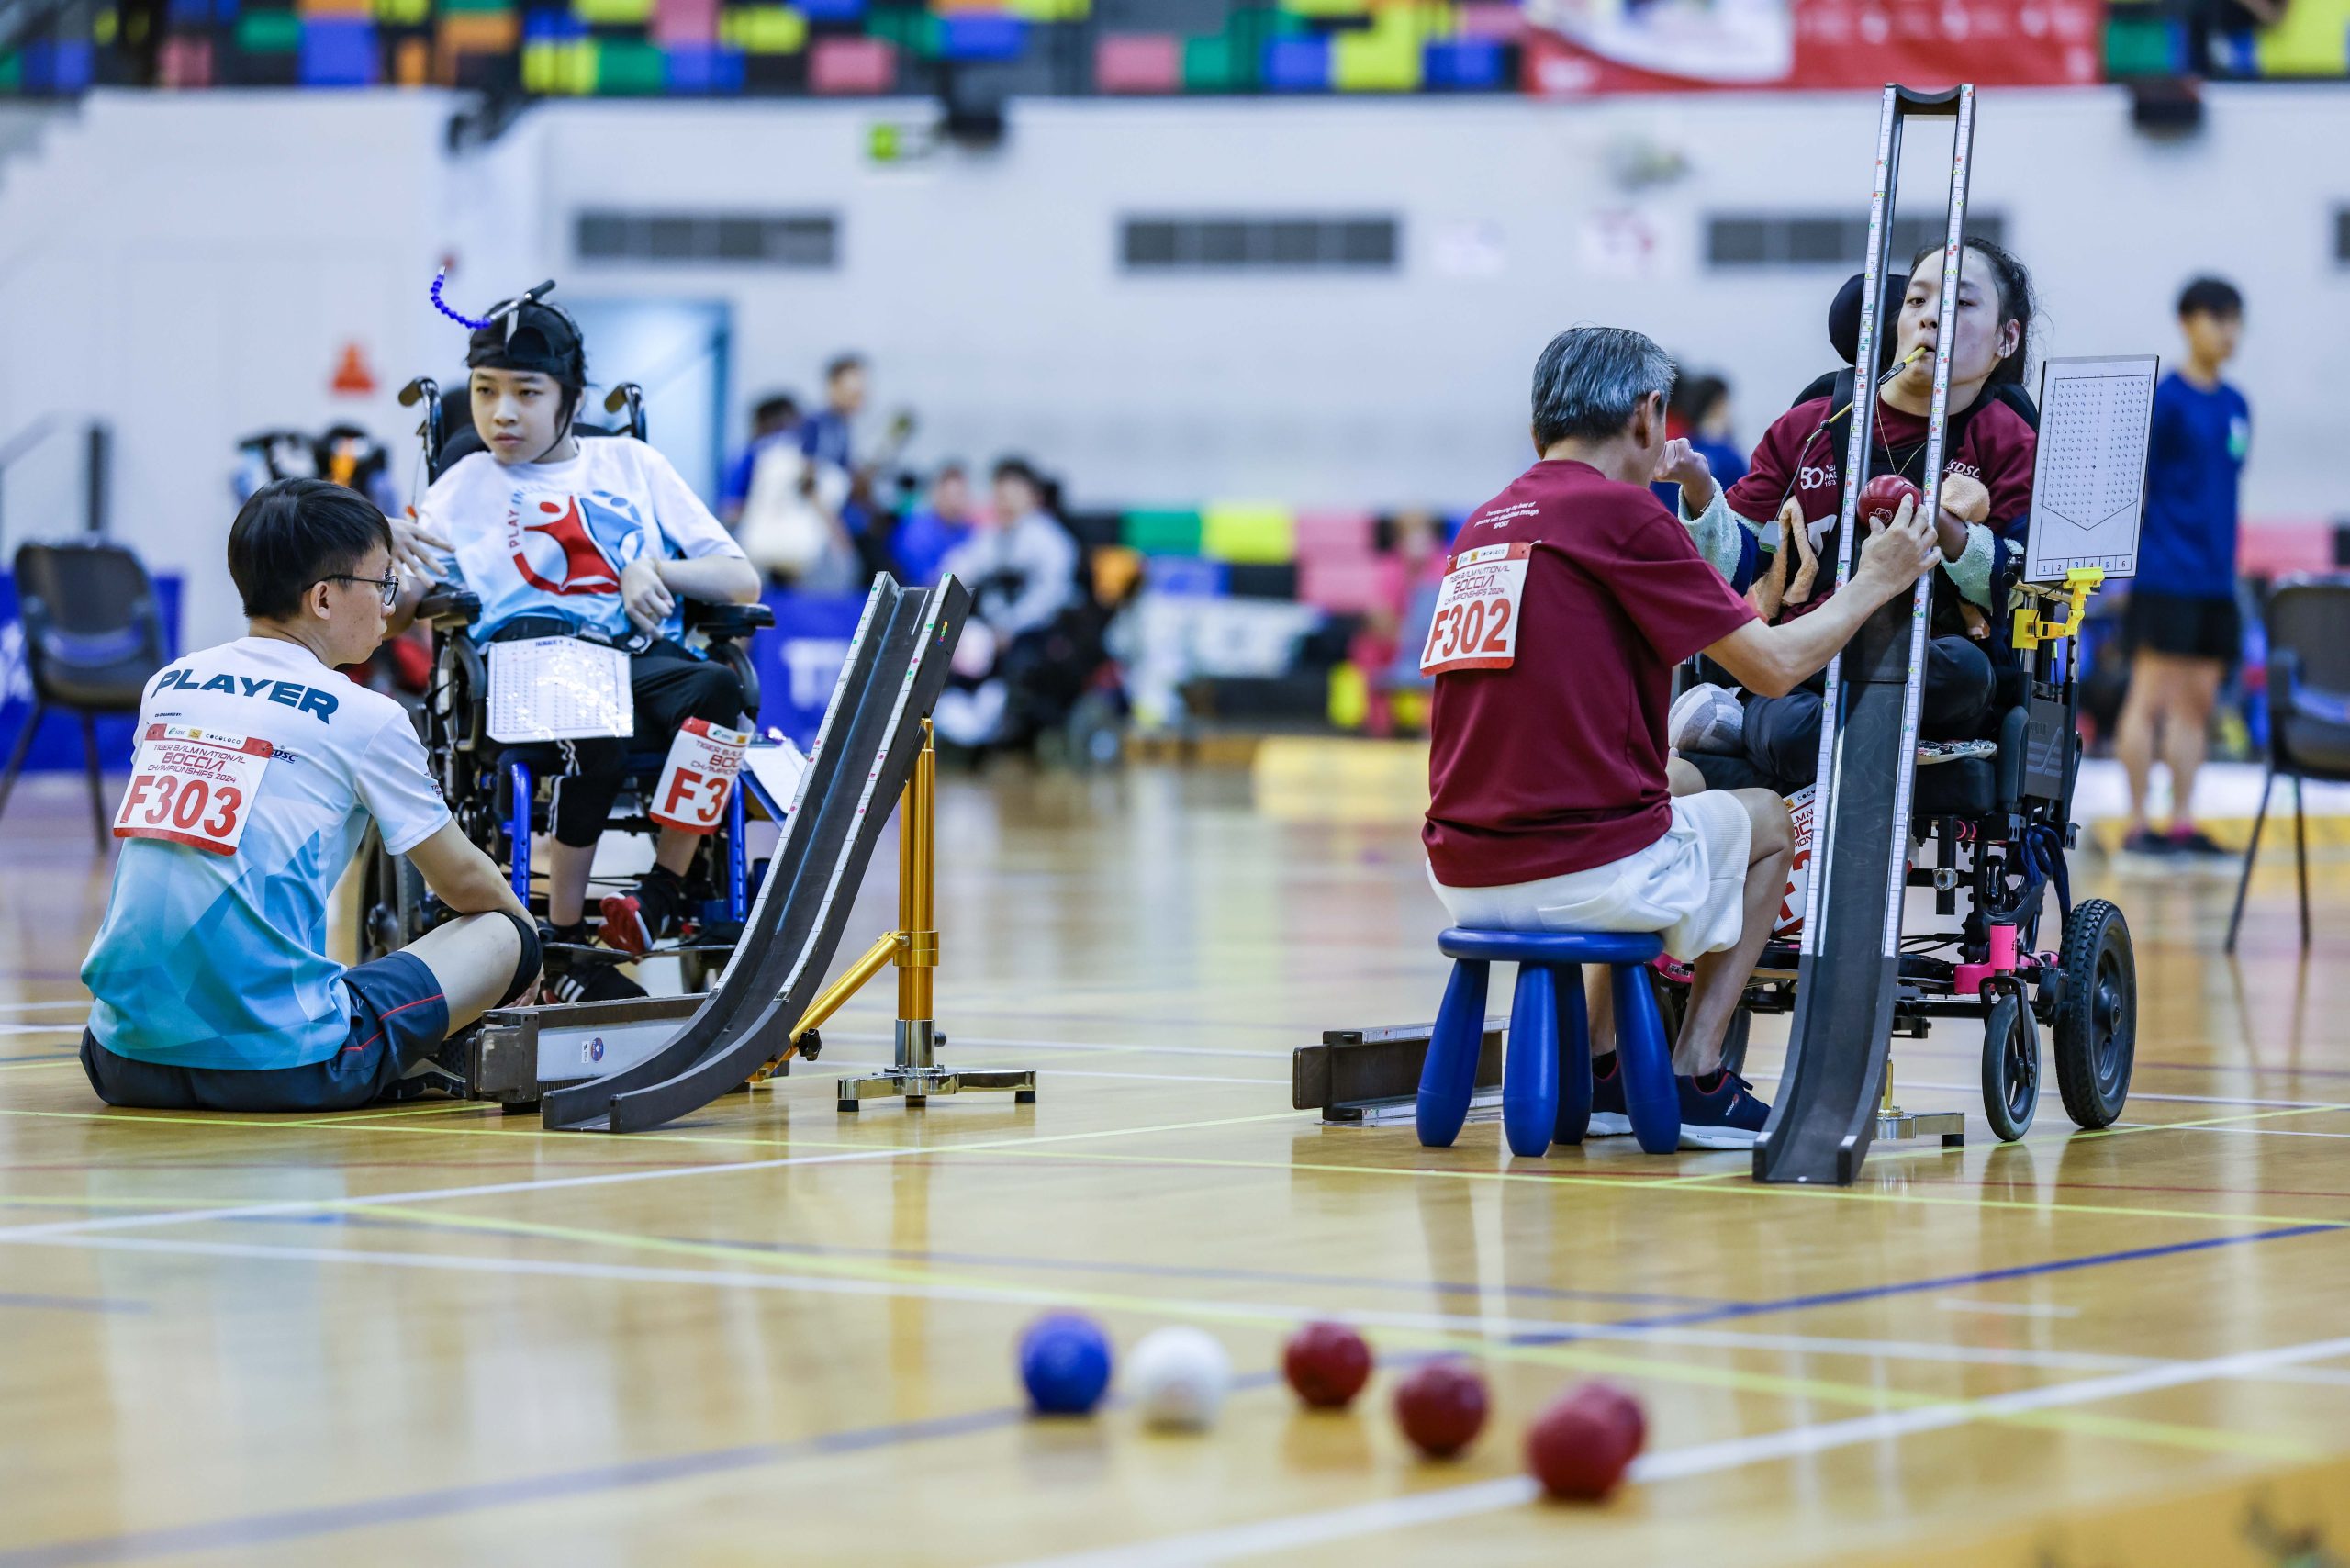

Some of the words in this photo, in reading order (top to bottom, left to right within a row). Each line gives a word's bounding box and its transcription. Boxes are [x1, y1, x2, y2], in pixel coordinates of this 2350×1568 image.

[1800, 466, 1824, 490] 50
[508, 510, 520, 549] PLAY
[1454, 574, 1495, 594] BOCCIA
[1425, 598, 1511, 663] F302
[151, 668, 339, 724] PLAYER
[162, 752, 226, 772] BOCCIA
[173, 745, 199, 755] BALM
[199, 748, 246, 764] NATIONAL
[148, 765, 214, 778] CHAMPIONSHIPS
[214, 773, 237, 783] 2024
[119, 775, 242, 838] F303
[664, 767, 728, 823] F3
